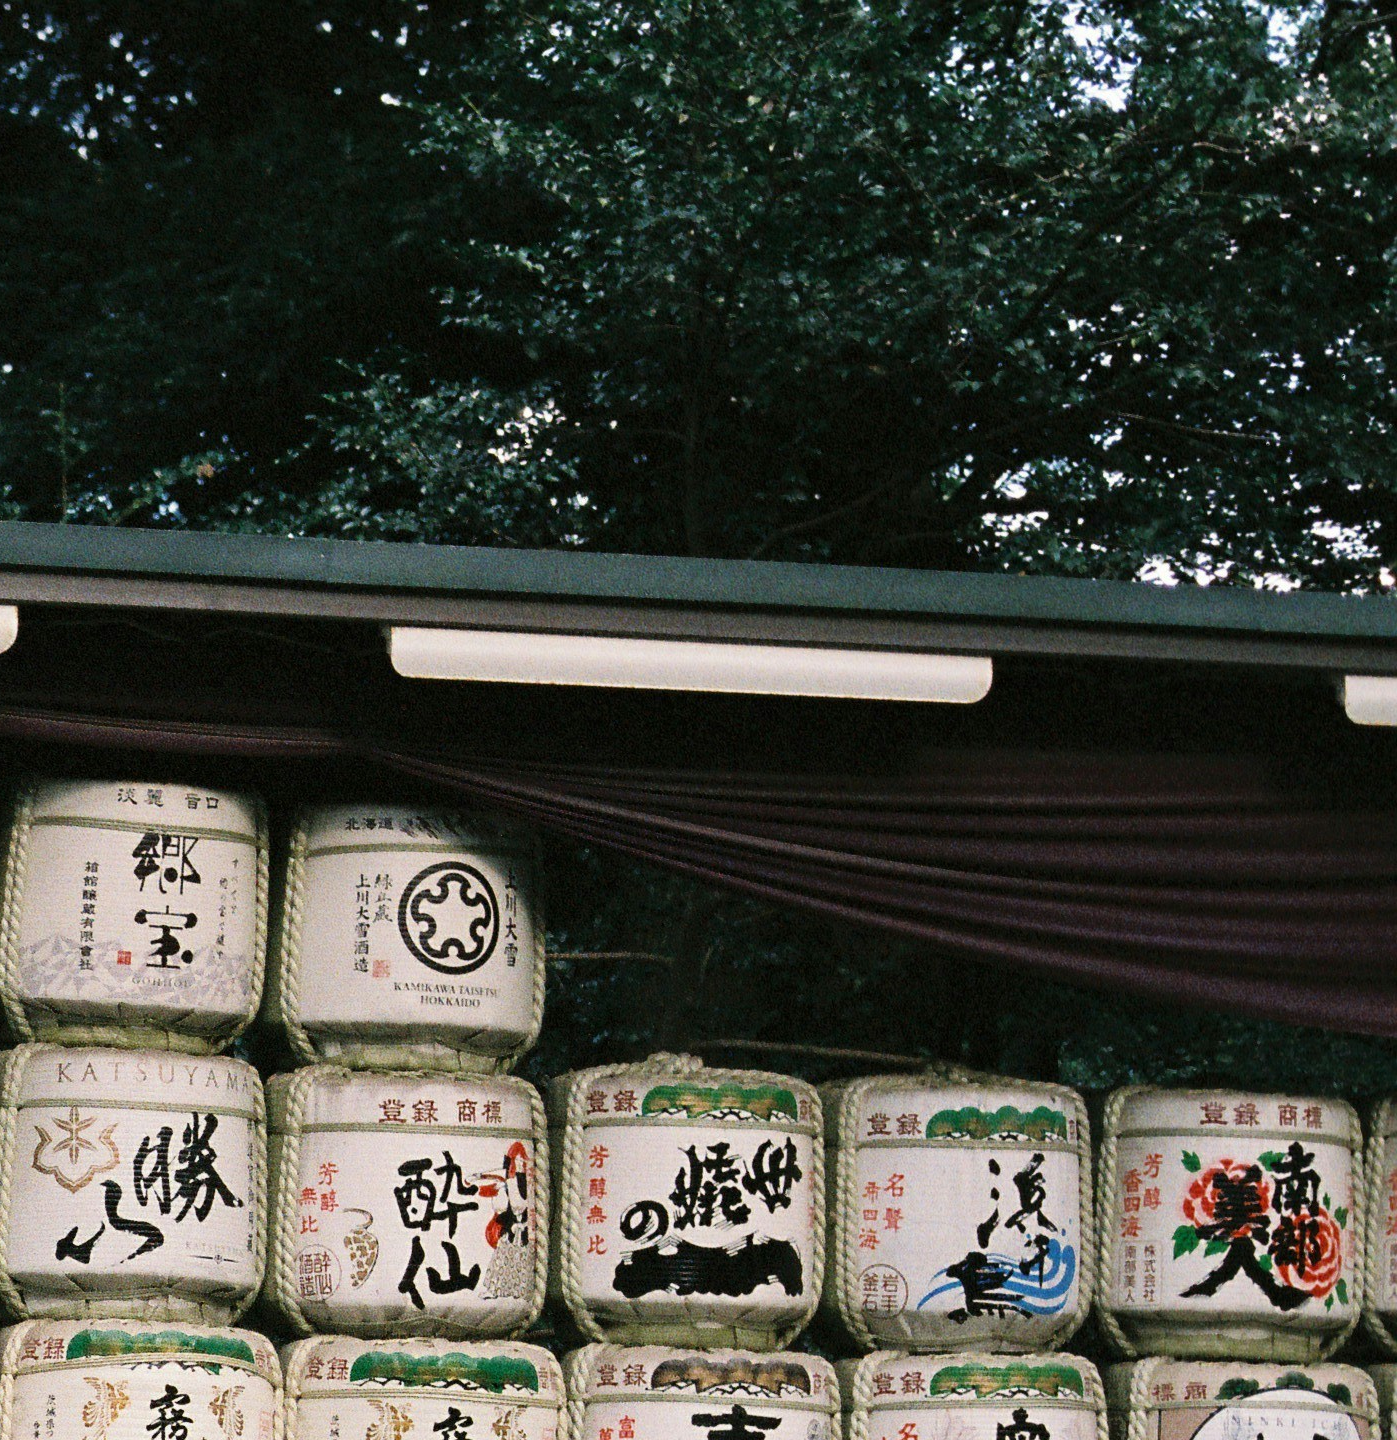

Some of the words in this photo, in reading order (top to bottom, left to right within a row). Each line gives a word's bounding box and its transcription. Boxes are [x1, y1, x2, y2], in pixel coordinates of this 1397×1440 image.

[353, 874, 371, 973] 上川大雪酒造
[394, 981, 457, 994] KAMIKAWA
[420, 996, 480, 1009] HOKKAIDO
[57, 1062, 250, 1094] KATSUYAMA
[588, 1091, 638, 1114] 登録
[868, 1113, 921, 1136] 登録
[56, 1112, 243, 1265] 勝山
[318, 1163, 338, 1211] 芳醇
[1142, 1153, 1162, 1209] 芳醇
[588, 1146, 608, 1256] 芳醇無比
[394, 1149, 480, 1309] 酔仙
[306, 1358, 348, 1380] 登録
[597, 1365, 646, 1387] 登録
[873, 1373, 926, 1395] 登録
